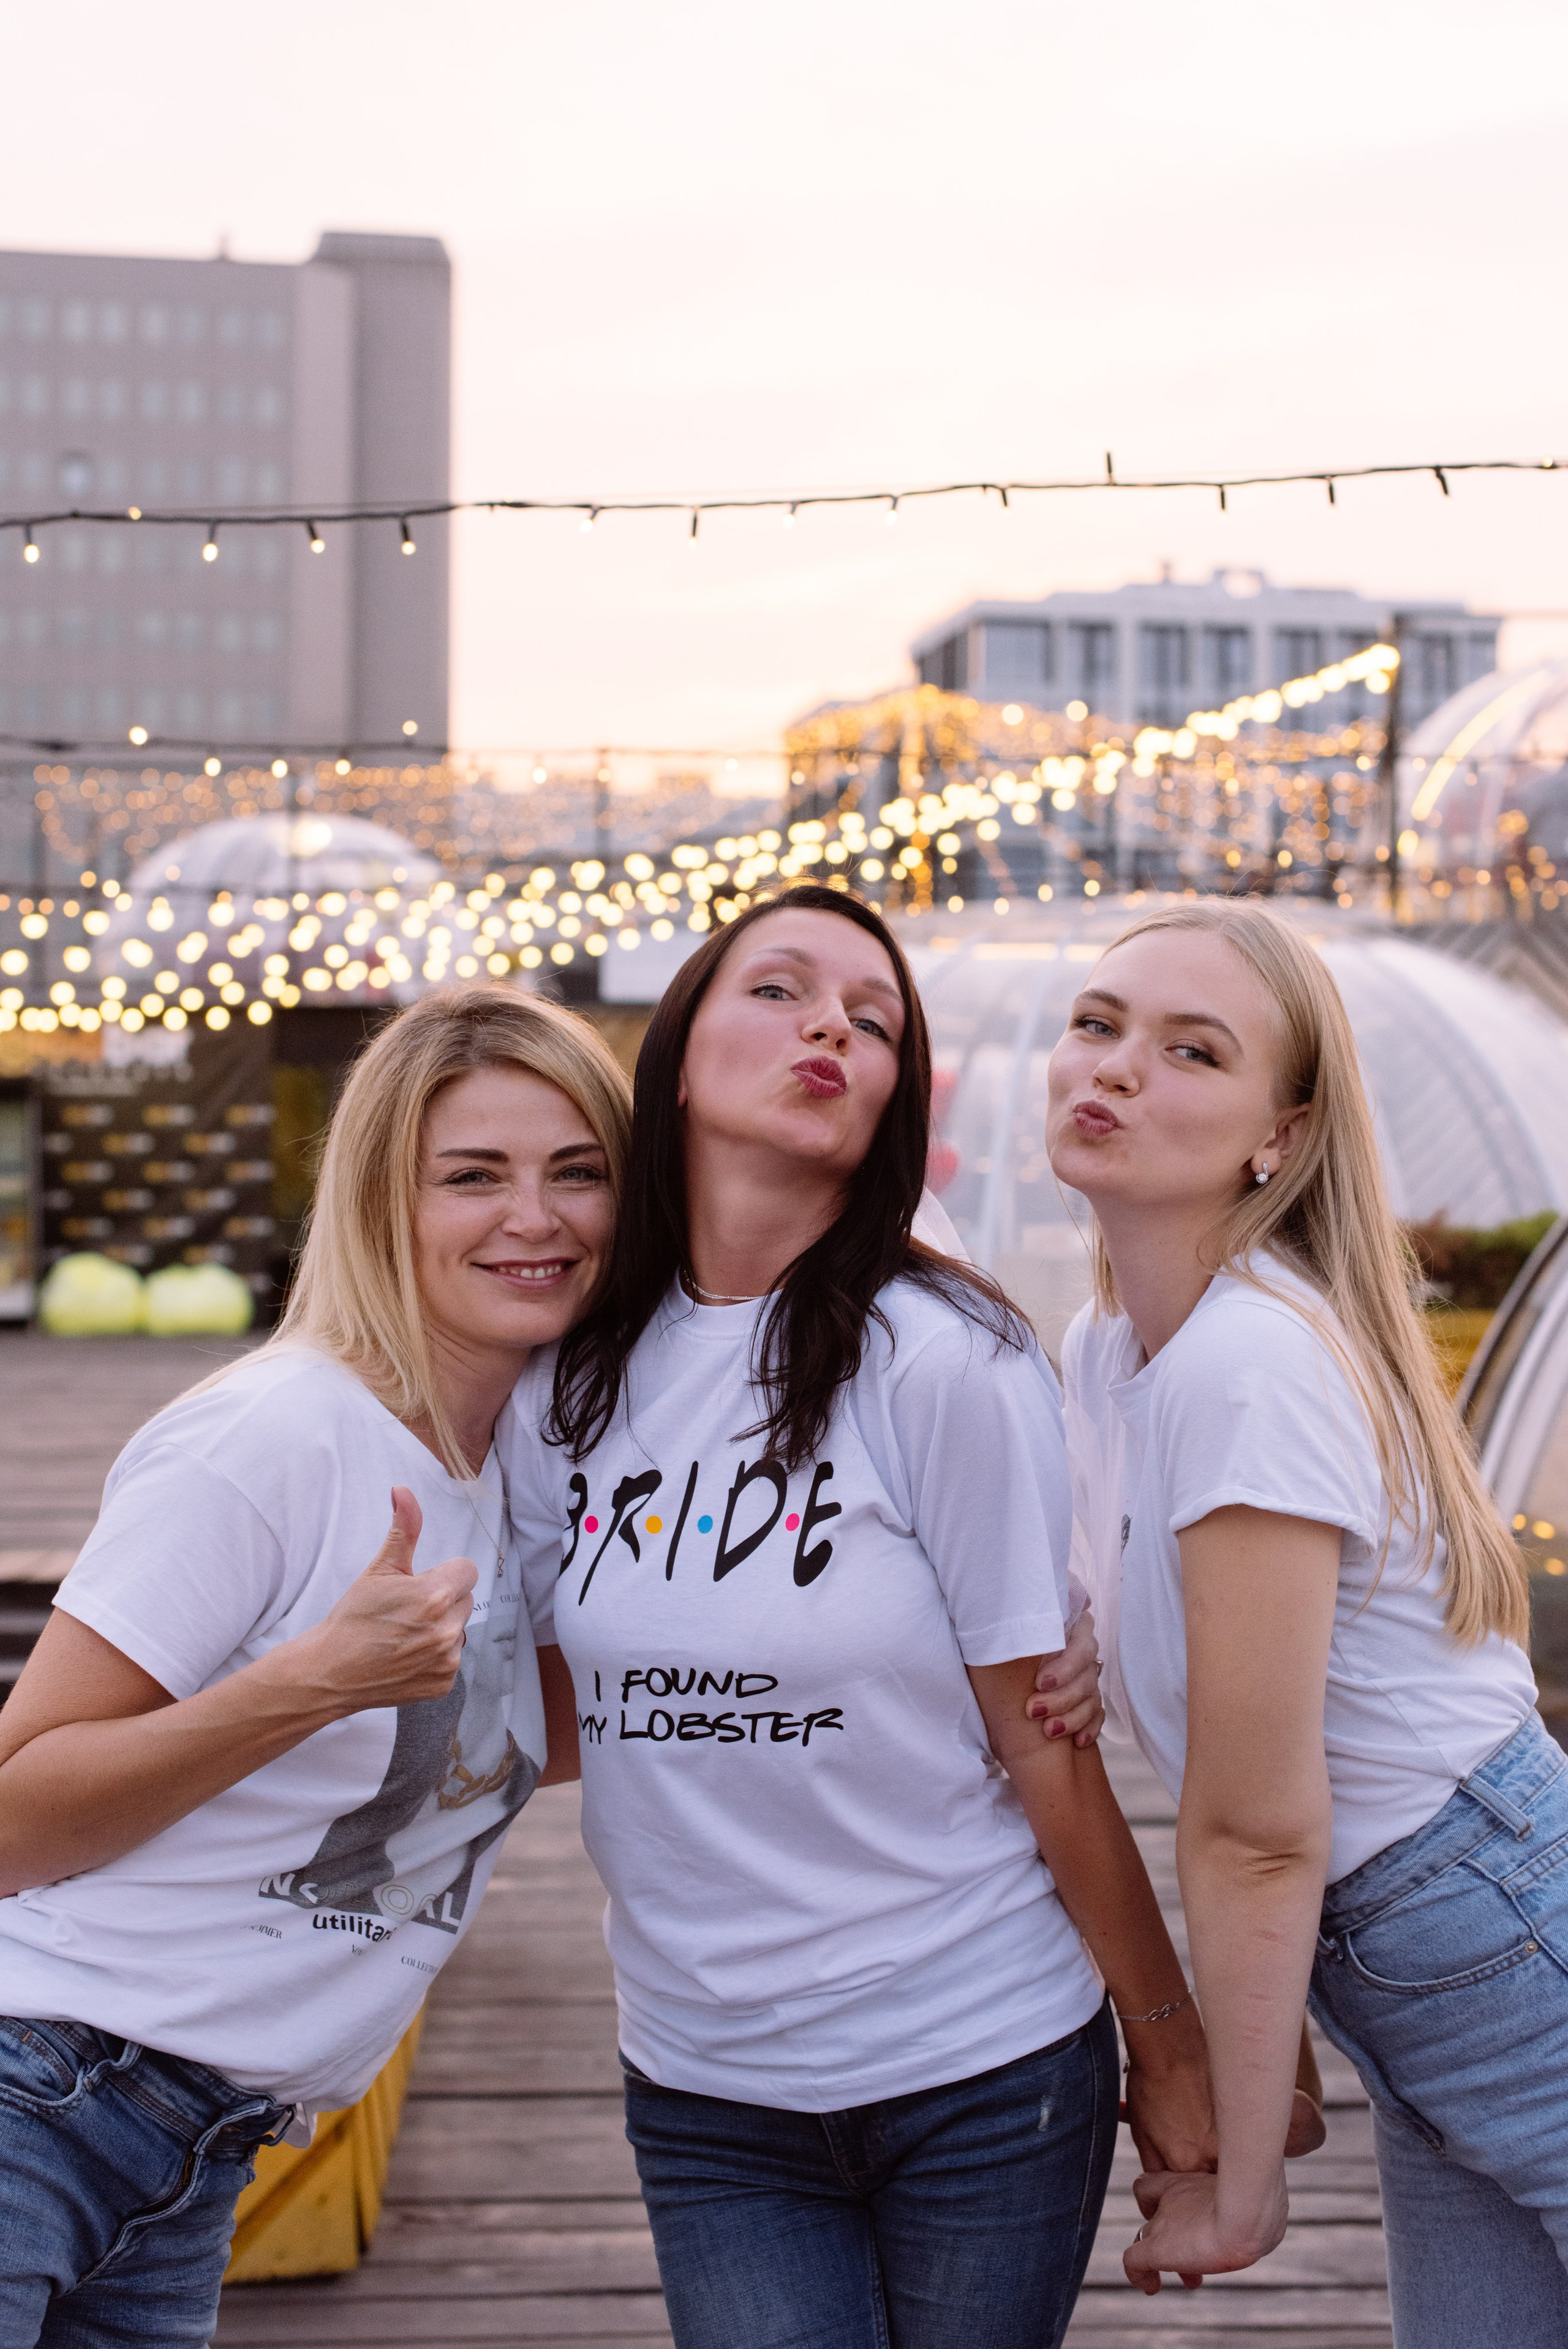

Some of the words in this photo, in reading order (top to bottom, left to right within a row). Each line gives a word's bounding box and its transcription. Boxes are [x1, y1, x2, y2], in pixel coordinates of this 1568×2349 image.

[594, 1670, 601, 1702] I
[621, 1667, 778, 1703] FOUND
[620, 1708, 844, 1747] LOBSTER
